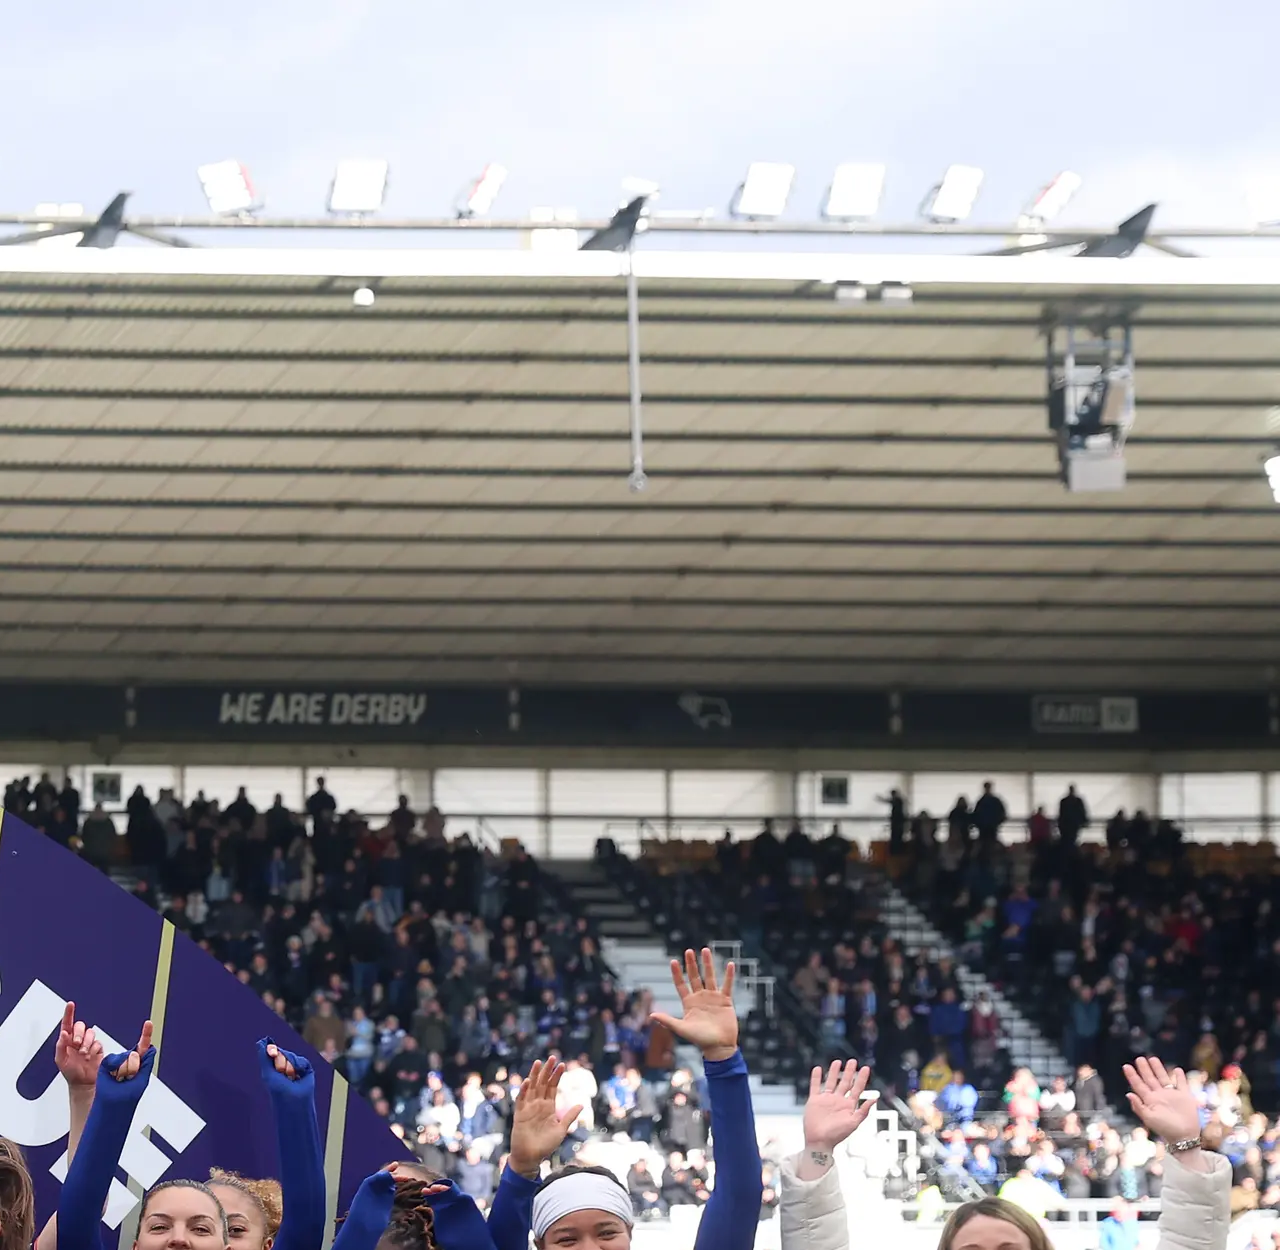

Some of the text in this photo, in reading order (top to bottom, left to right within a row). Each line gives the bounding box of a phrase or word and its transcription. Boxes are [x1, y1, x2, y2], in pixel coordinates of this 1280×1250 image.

[219, 692, 427, 725] WE ARE DERBY
